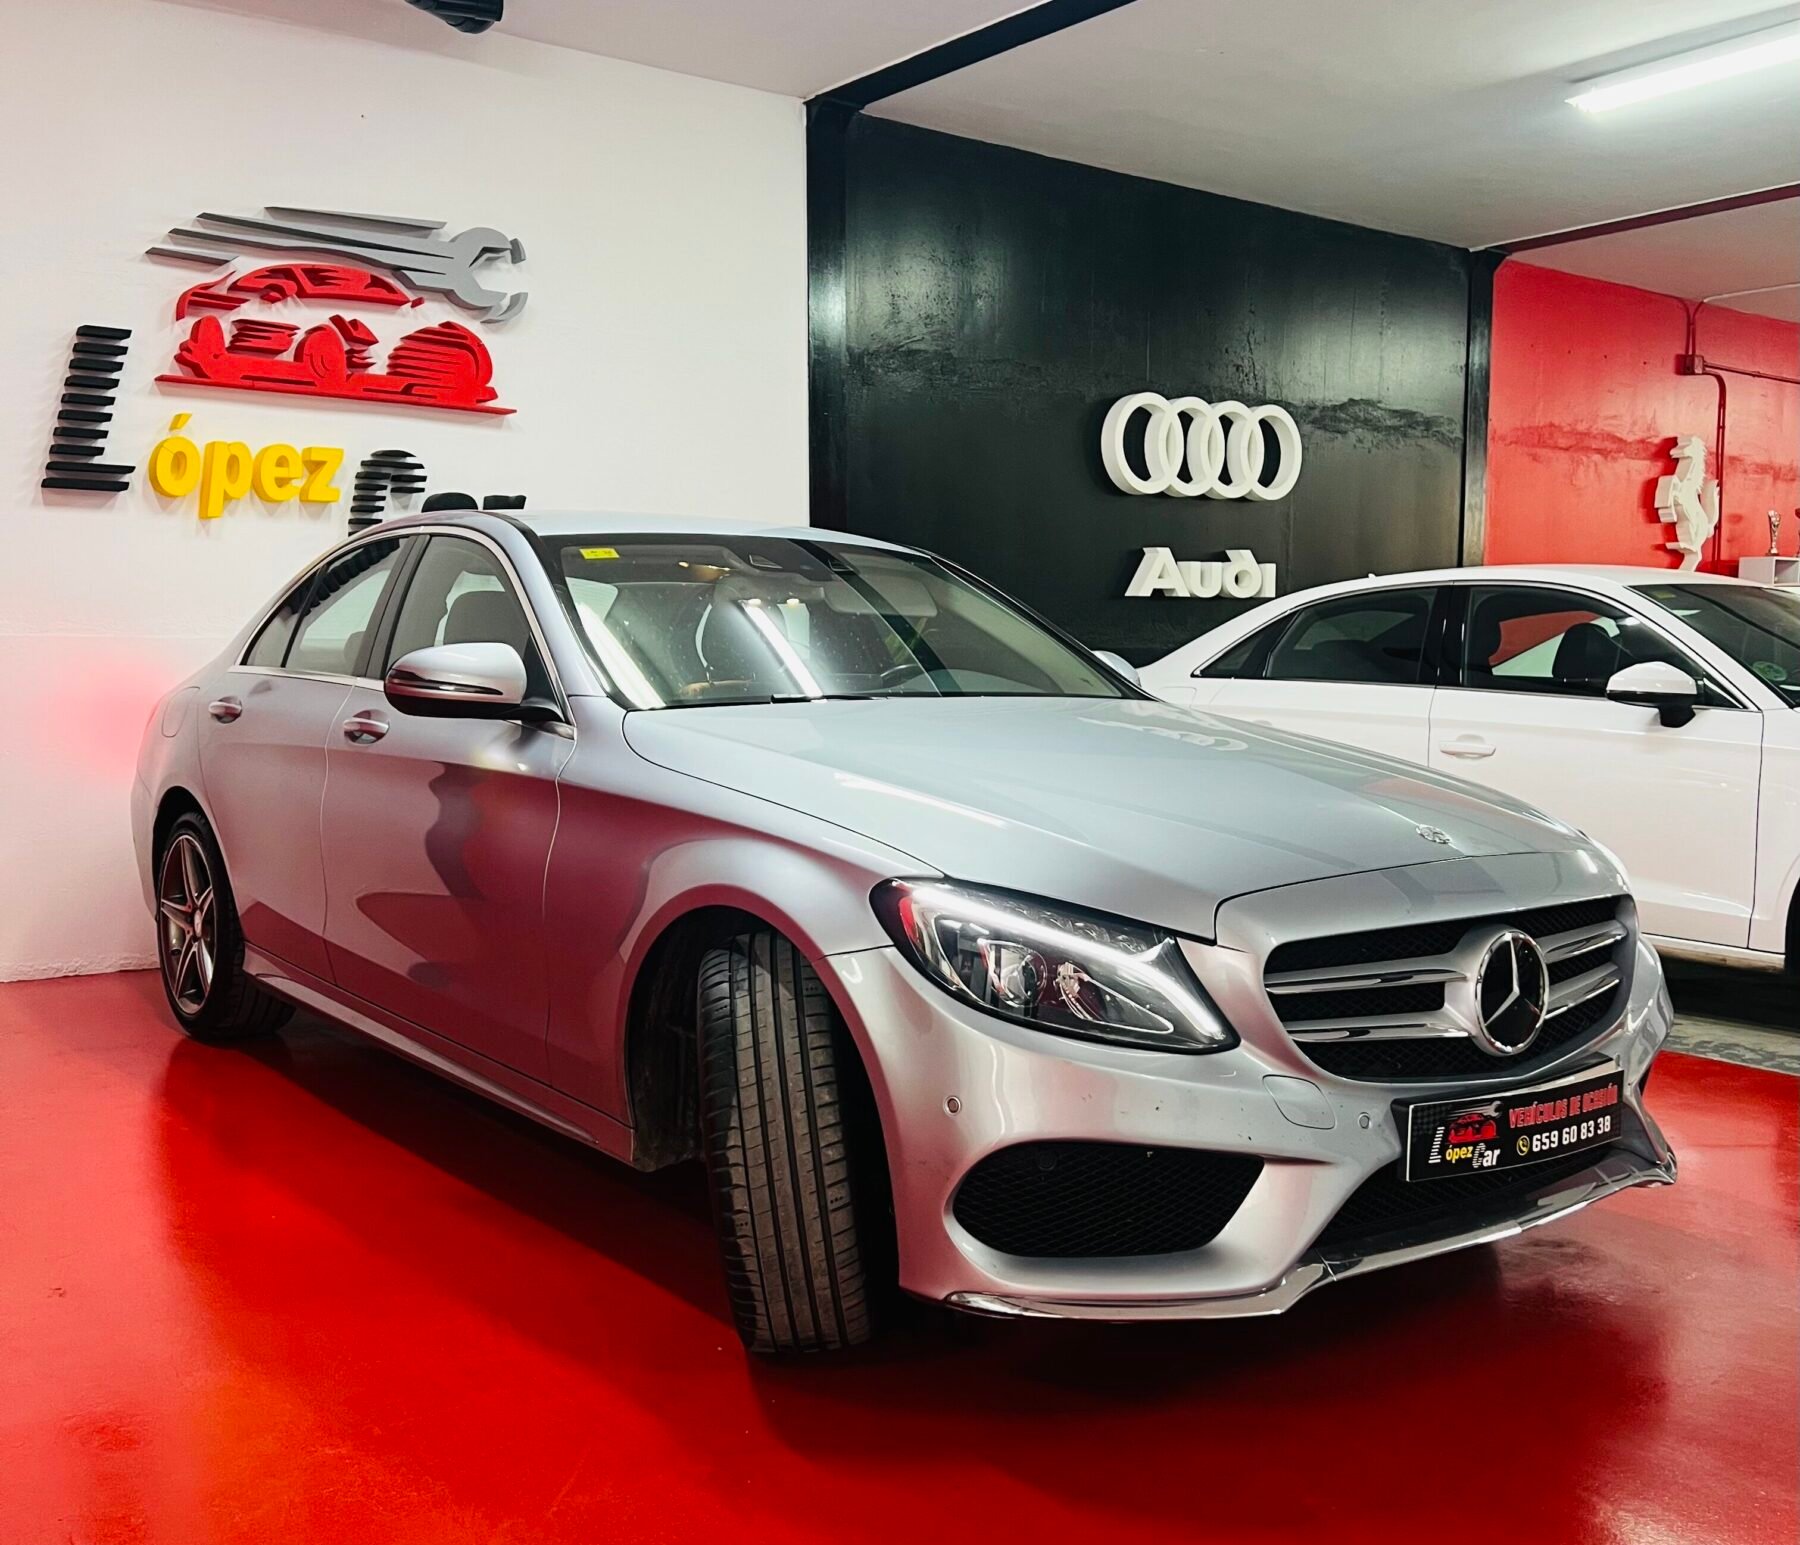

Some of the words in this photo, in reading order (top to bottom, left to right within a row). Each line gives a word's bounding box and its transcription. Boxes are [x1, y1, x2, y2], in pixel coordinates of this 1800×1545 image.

[1124, 546, 1277, 599] Audi
[1509, 1101, 1568, 1129] VEHÍCULOS
[1569, 1095, 1582, 1116] DE
[1532, 1130, 1559, 1152] 659
[1561, 1125, 1578, 1145] 60
[1580, 1120, 1595, 1140] 83
[1597, 1115, 1611, 1135] 38
[1471, 1142, 1501, 1169] Car
